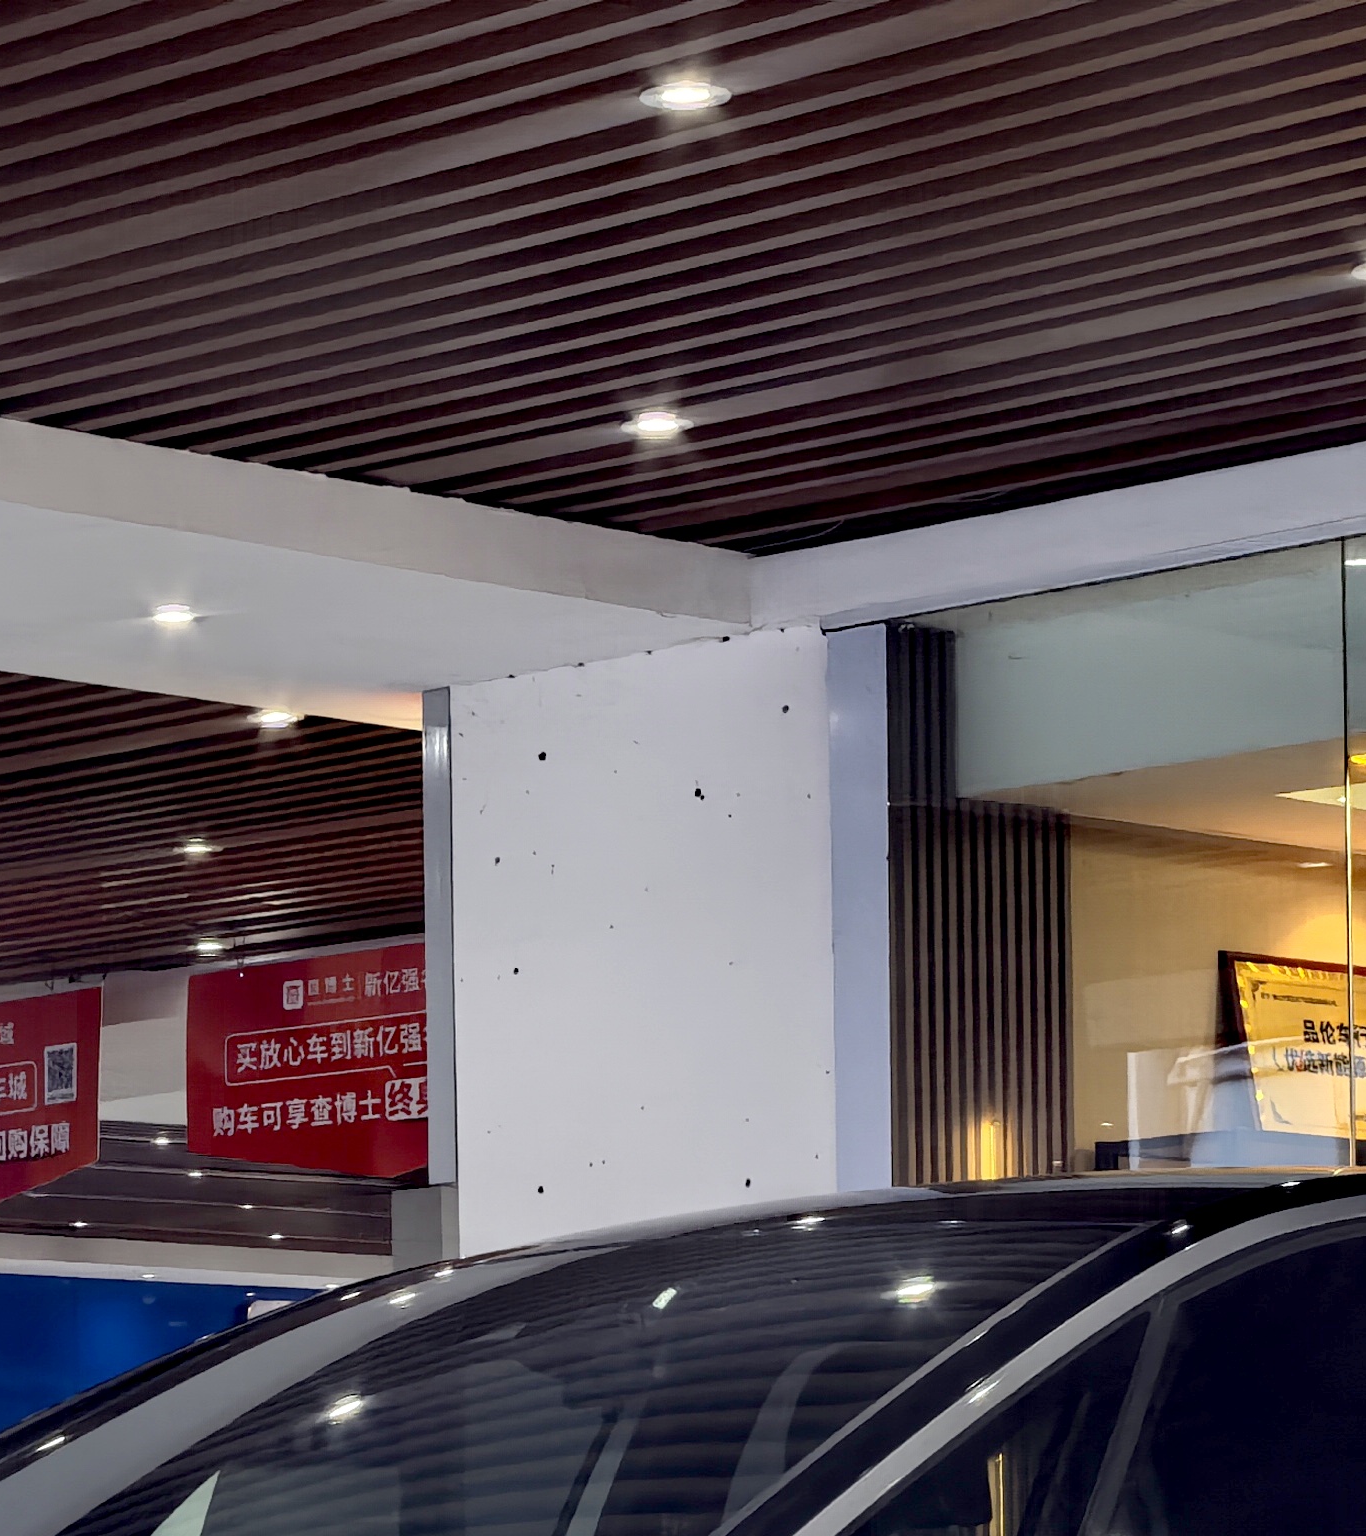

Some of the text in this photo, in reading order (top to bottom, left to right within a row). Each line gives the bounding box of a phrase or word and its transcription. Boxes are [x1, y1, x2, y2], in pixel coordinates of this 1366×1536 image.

[364, 967, 426, 998] 新亿强
[236, 1022, 428, 1074] 买放心车到新亿强
